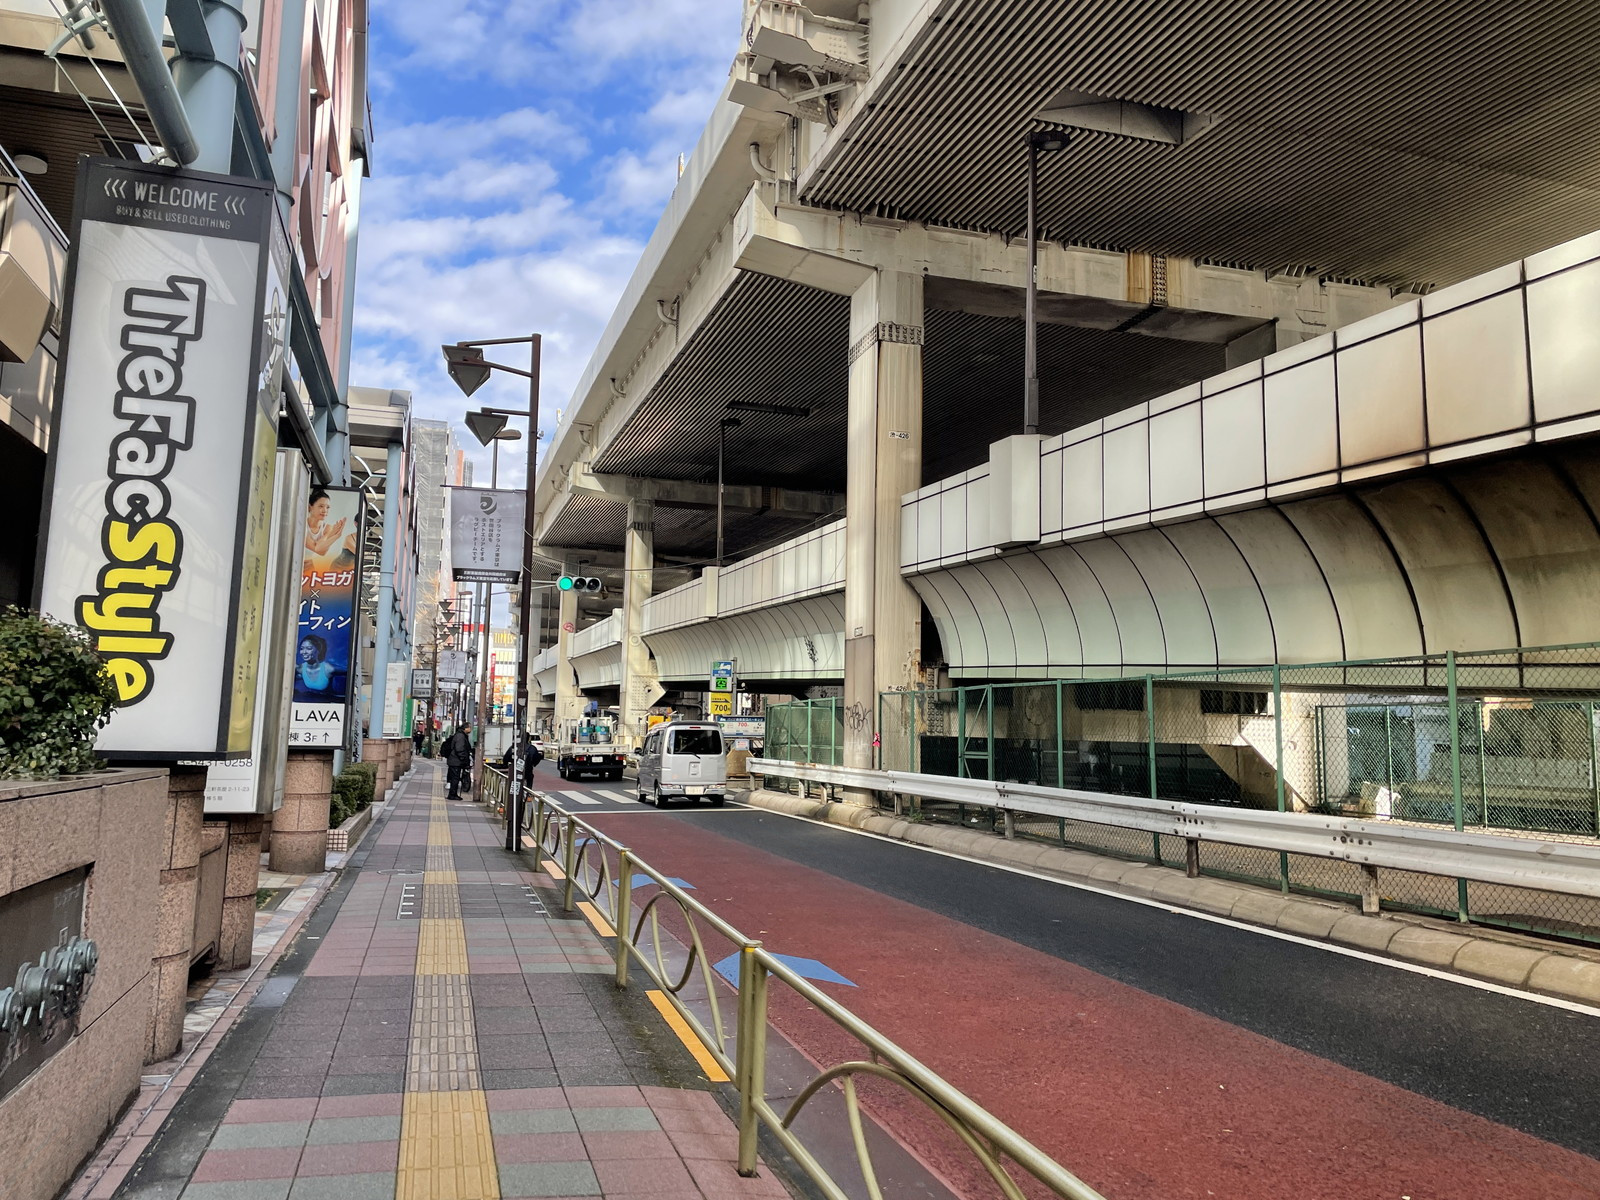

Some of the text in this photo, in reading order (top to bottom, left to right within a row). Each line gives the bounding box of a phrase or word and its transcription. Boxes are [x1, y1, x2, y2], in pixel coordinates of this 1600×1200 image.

[134, 181, 219, 212] WELCOME
[116, 205, 231, 230] BUY & SELL USED CLOTHING
[716, 678, 727, 689] 空
[295, 709, 341, 723] LAVA
[303, 732, 318, 743] 3F
